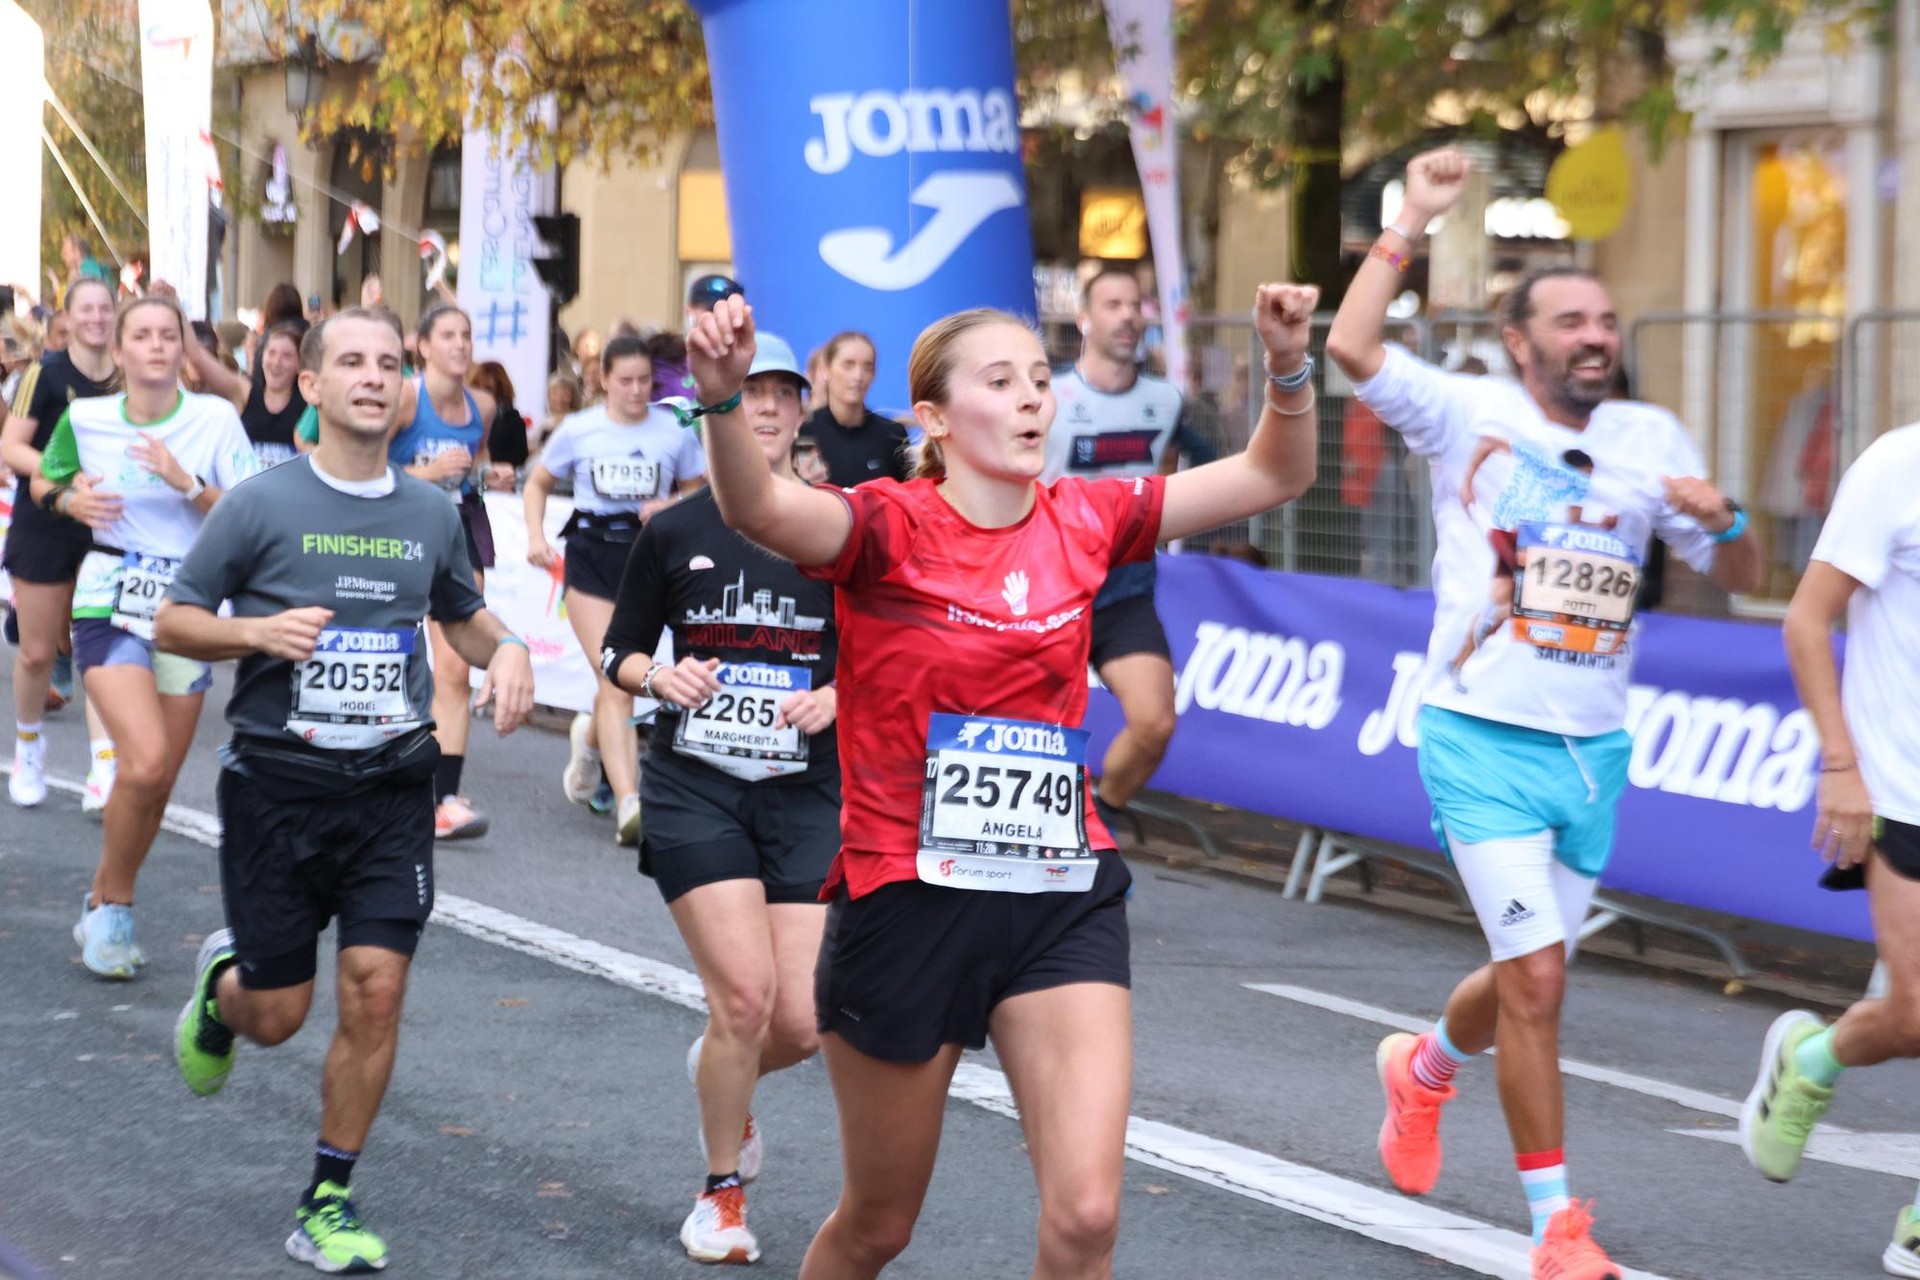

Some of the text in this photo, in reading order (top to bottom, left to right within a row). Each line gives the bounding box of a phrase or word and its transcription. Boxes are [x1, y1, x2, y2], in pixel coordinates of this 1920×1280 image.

[803, 87, 1020, 174] Joma
[1561, 531, 1628, 558] Joma
[1529, 556, 1632, 599] 12826
[336, 630, 400, 652] Joma
[686, 624, 823, 654] MILANO
[304, 660, 402, 692] 20552
[723, 663, 793, 688] Joma
[1173, 619, 1346, 730] Joma
[703, 729, 780, 747] MARGHERITA
[985, 724, 1068, 757] Joma
[940, 762, 1073, 818] 25749
[985, 870, 1013, 880] sport
